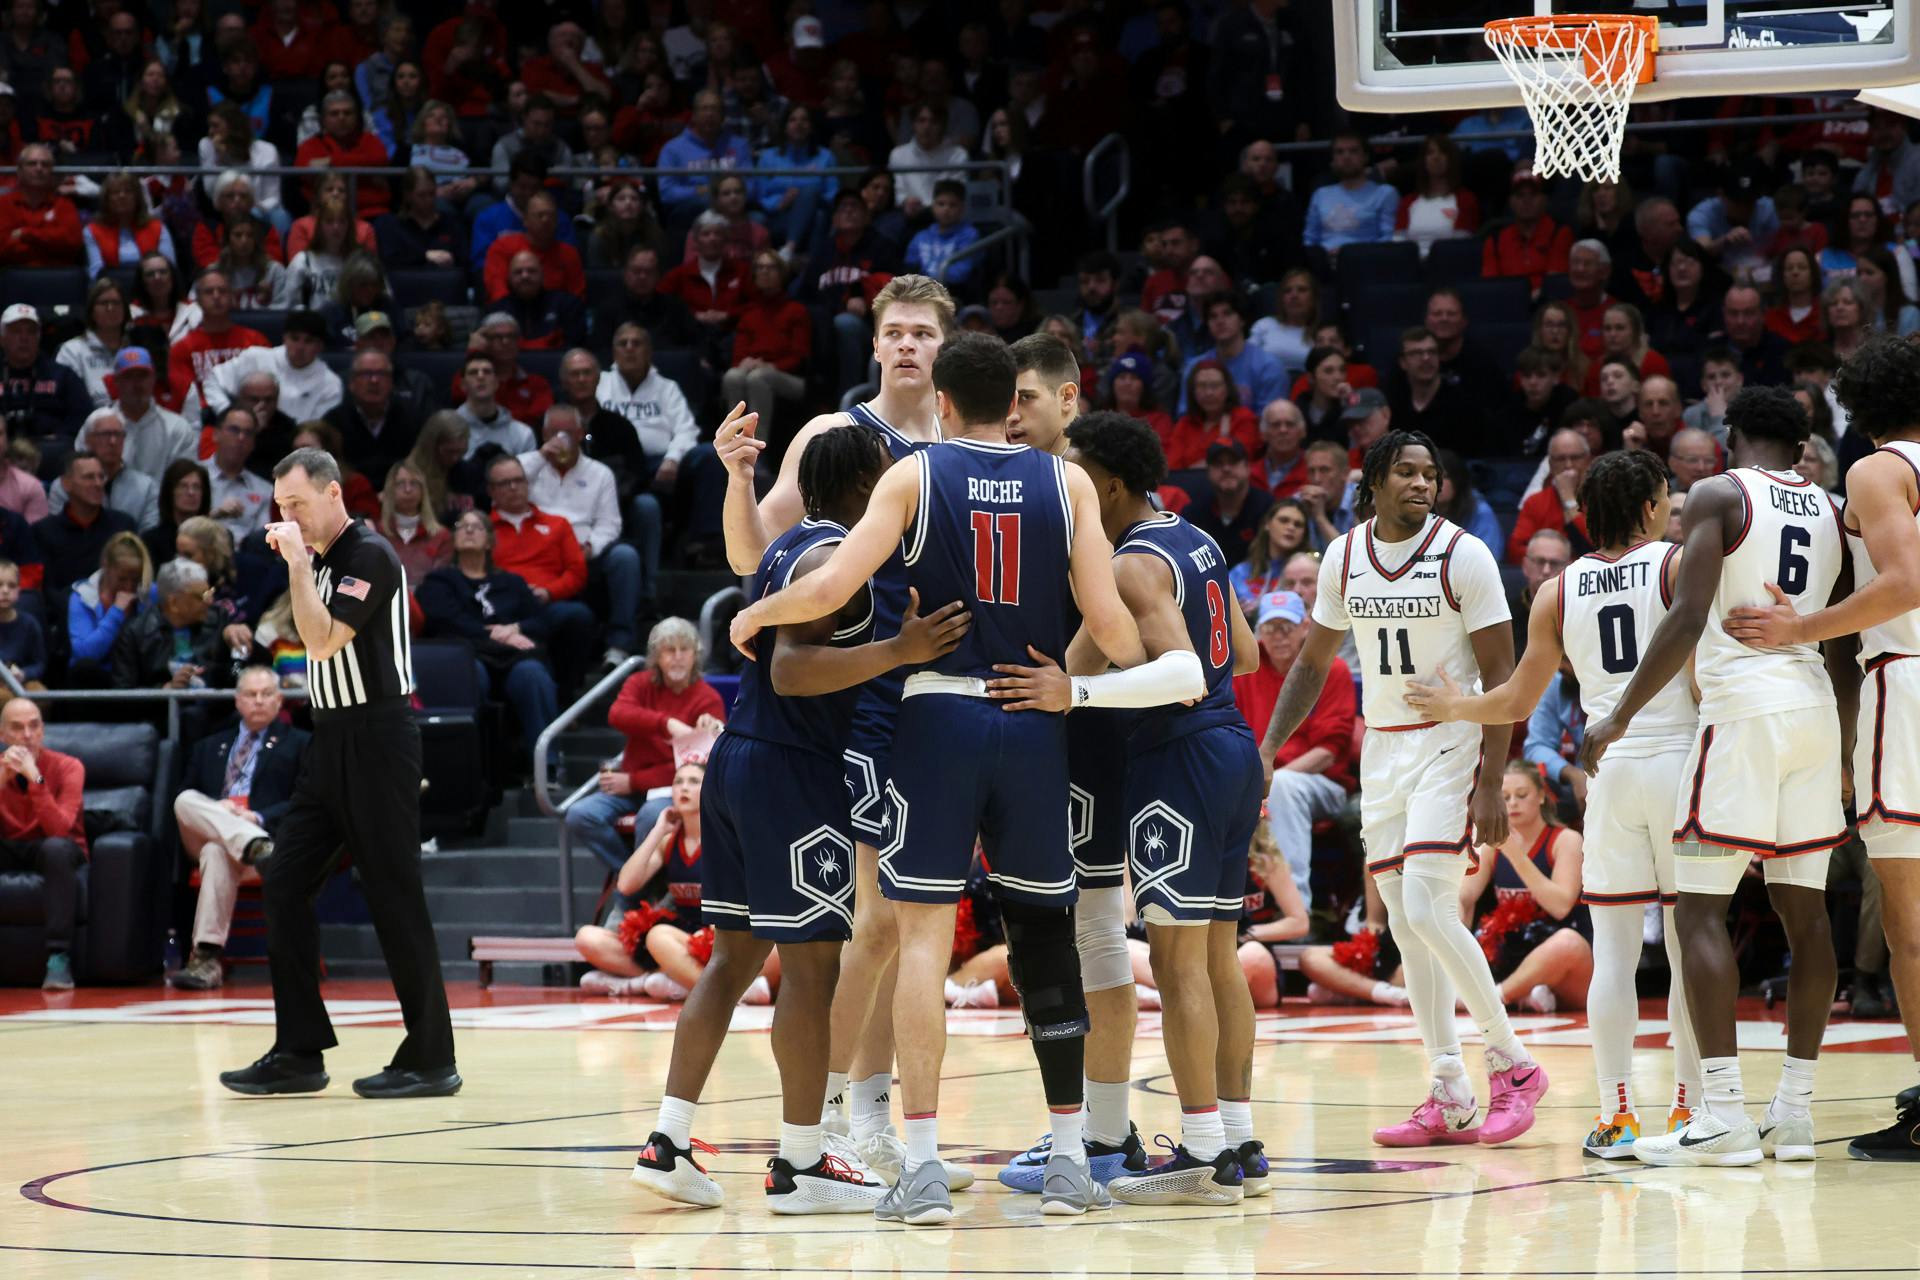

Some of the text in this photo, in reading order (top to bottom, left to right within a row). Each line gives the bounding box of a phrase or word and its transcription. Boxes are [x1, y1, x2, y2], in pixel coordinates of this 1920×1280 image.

[967, 477, 1023, 503] ROCHE
[1770, 485, 1820, 517] CHEEKS
[970, 510, 1020, 606] 11
[1777, 524, 1811, 596] 6
[1578, 562, 1650, 597] BENNETT
[1206, 579, 1230, 669] 8
[1348, 596, 1440, 618] DAYTON
[1378, 628, 1416, 675] 11
[1597, 603, 1638, 674] 0
[1041, 1026, 1078, 1037] DONJOY
